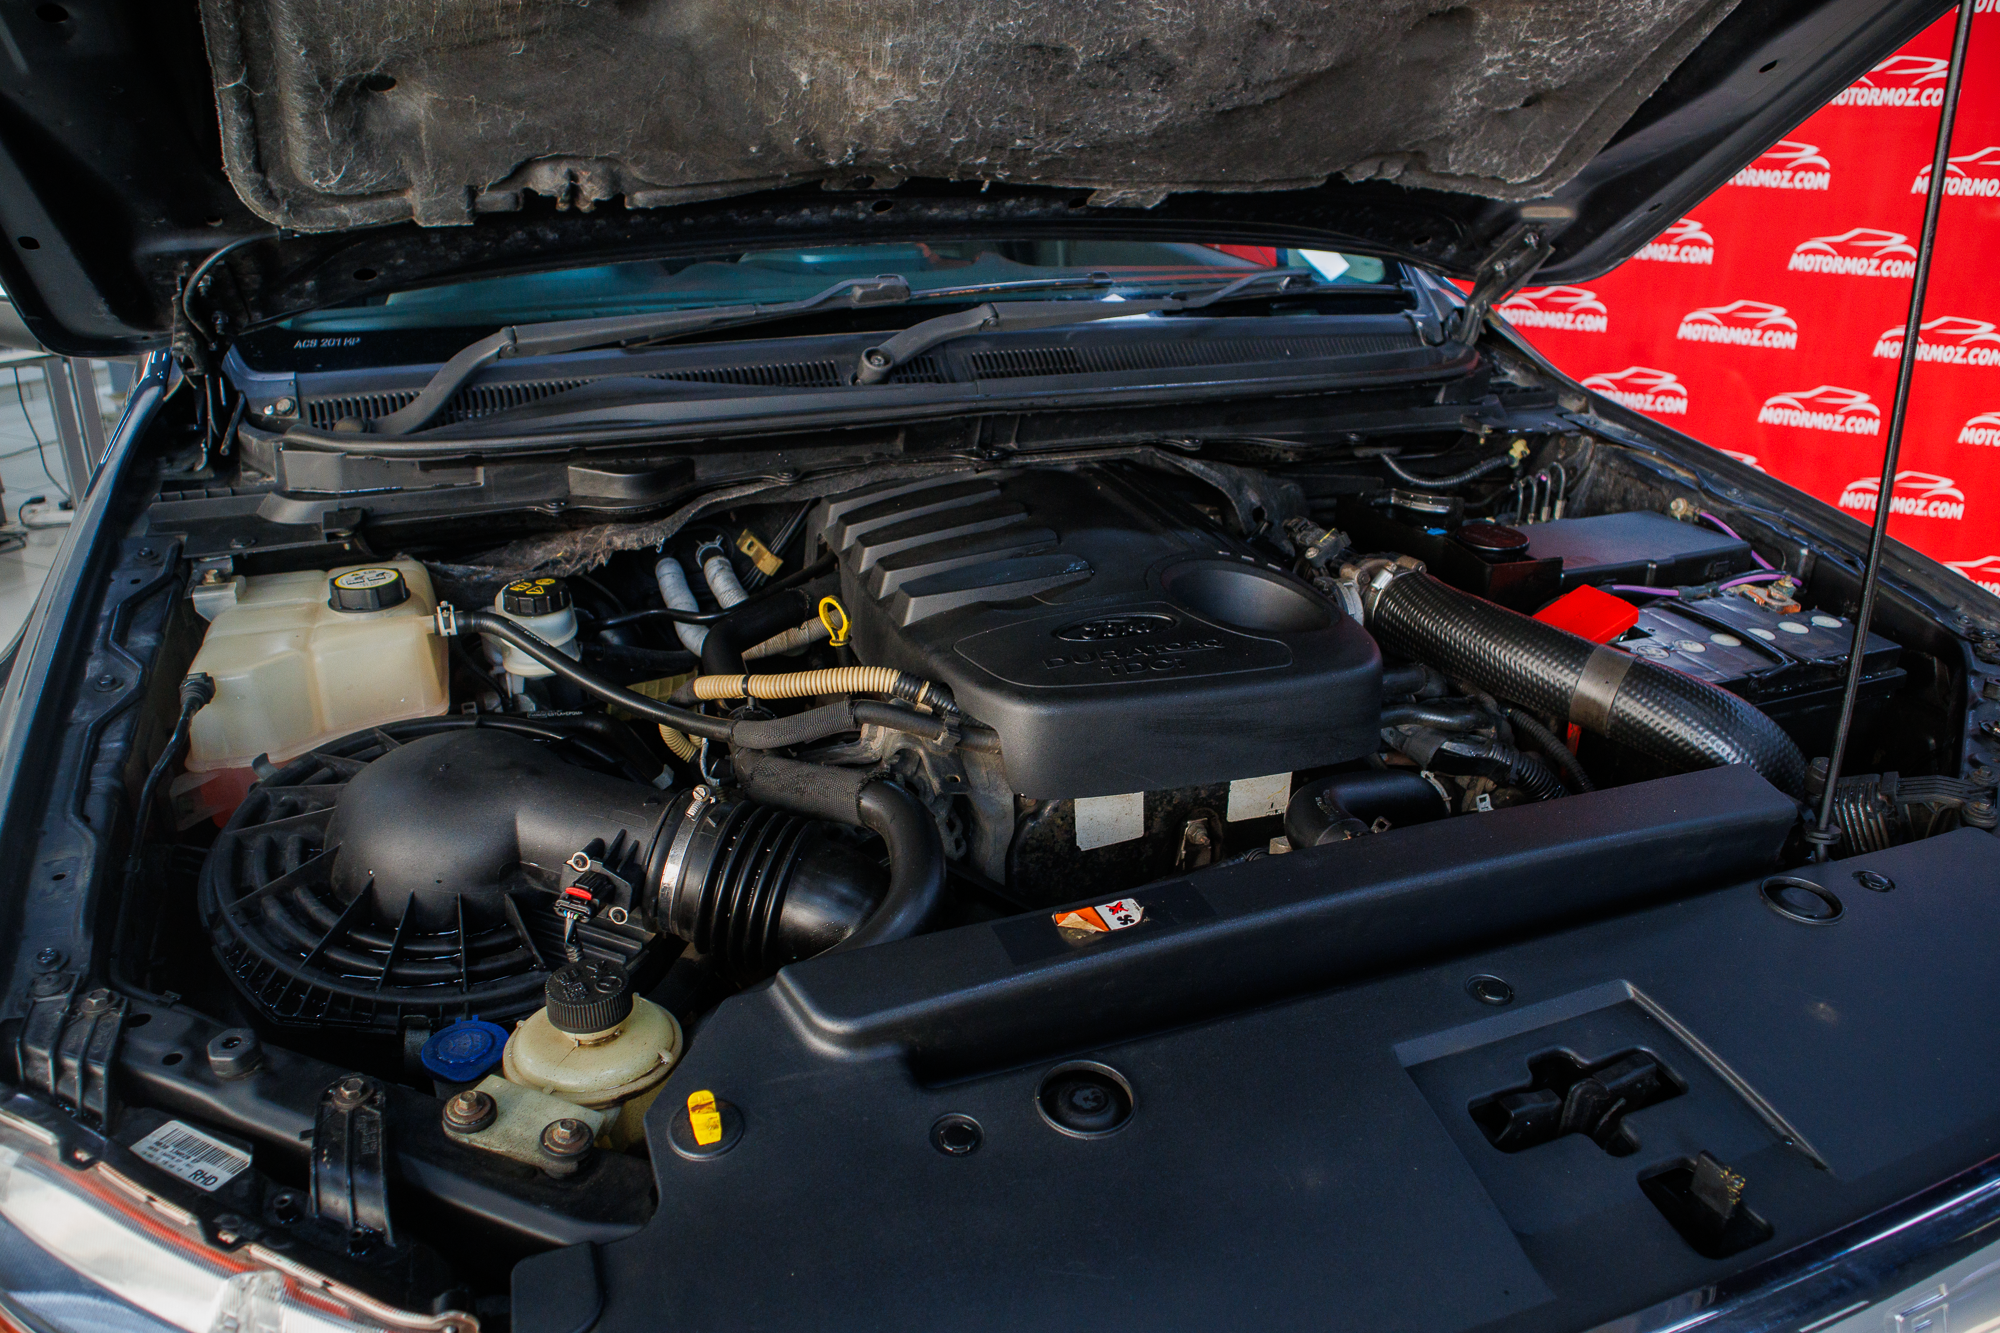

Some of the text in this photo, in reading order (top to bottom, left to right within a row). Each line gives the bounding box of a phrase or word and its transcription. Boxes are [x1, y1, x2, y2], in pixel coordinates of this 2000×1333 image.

[1831, 87, 1945, 107] OTORMOZ.CO
[1788, 253, 1917, 279] MOTORMOZ.COM
[1677, 322, 1798, 350] MOTORMOZ.COM
[1873, 340, 2000, 366] MORMOZ.COM
[1758, 406, 1881, 436] MOTORMOZ.COM
[1042, 638, 1226, 670] DURATORQ
[188, 1168, 219, 1187] RHD
